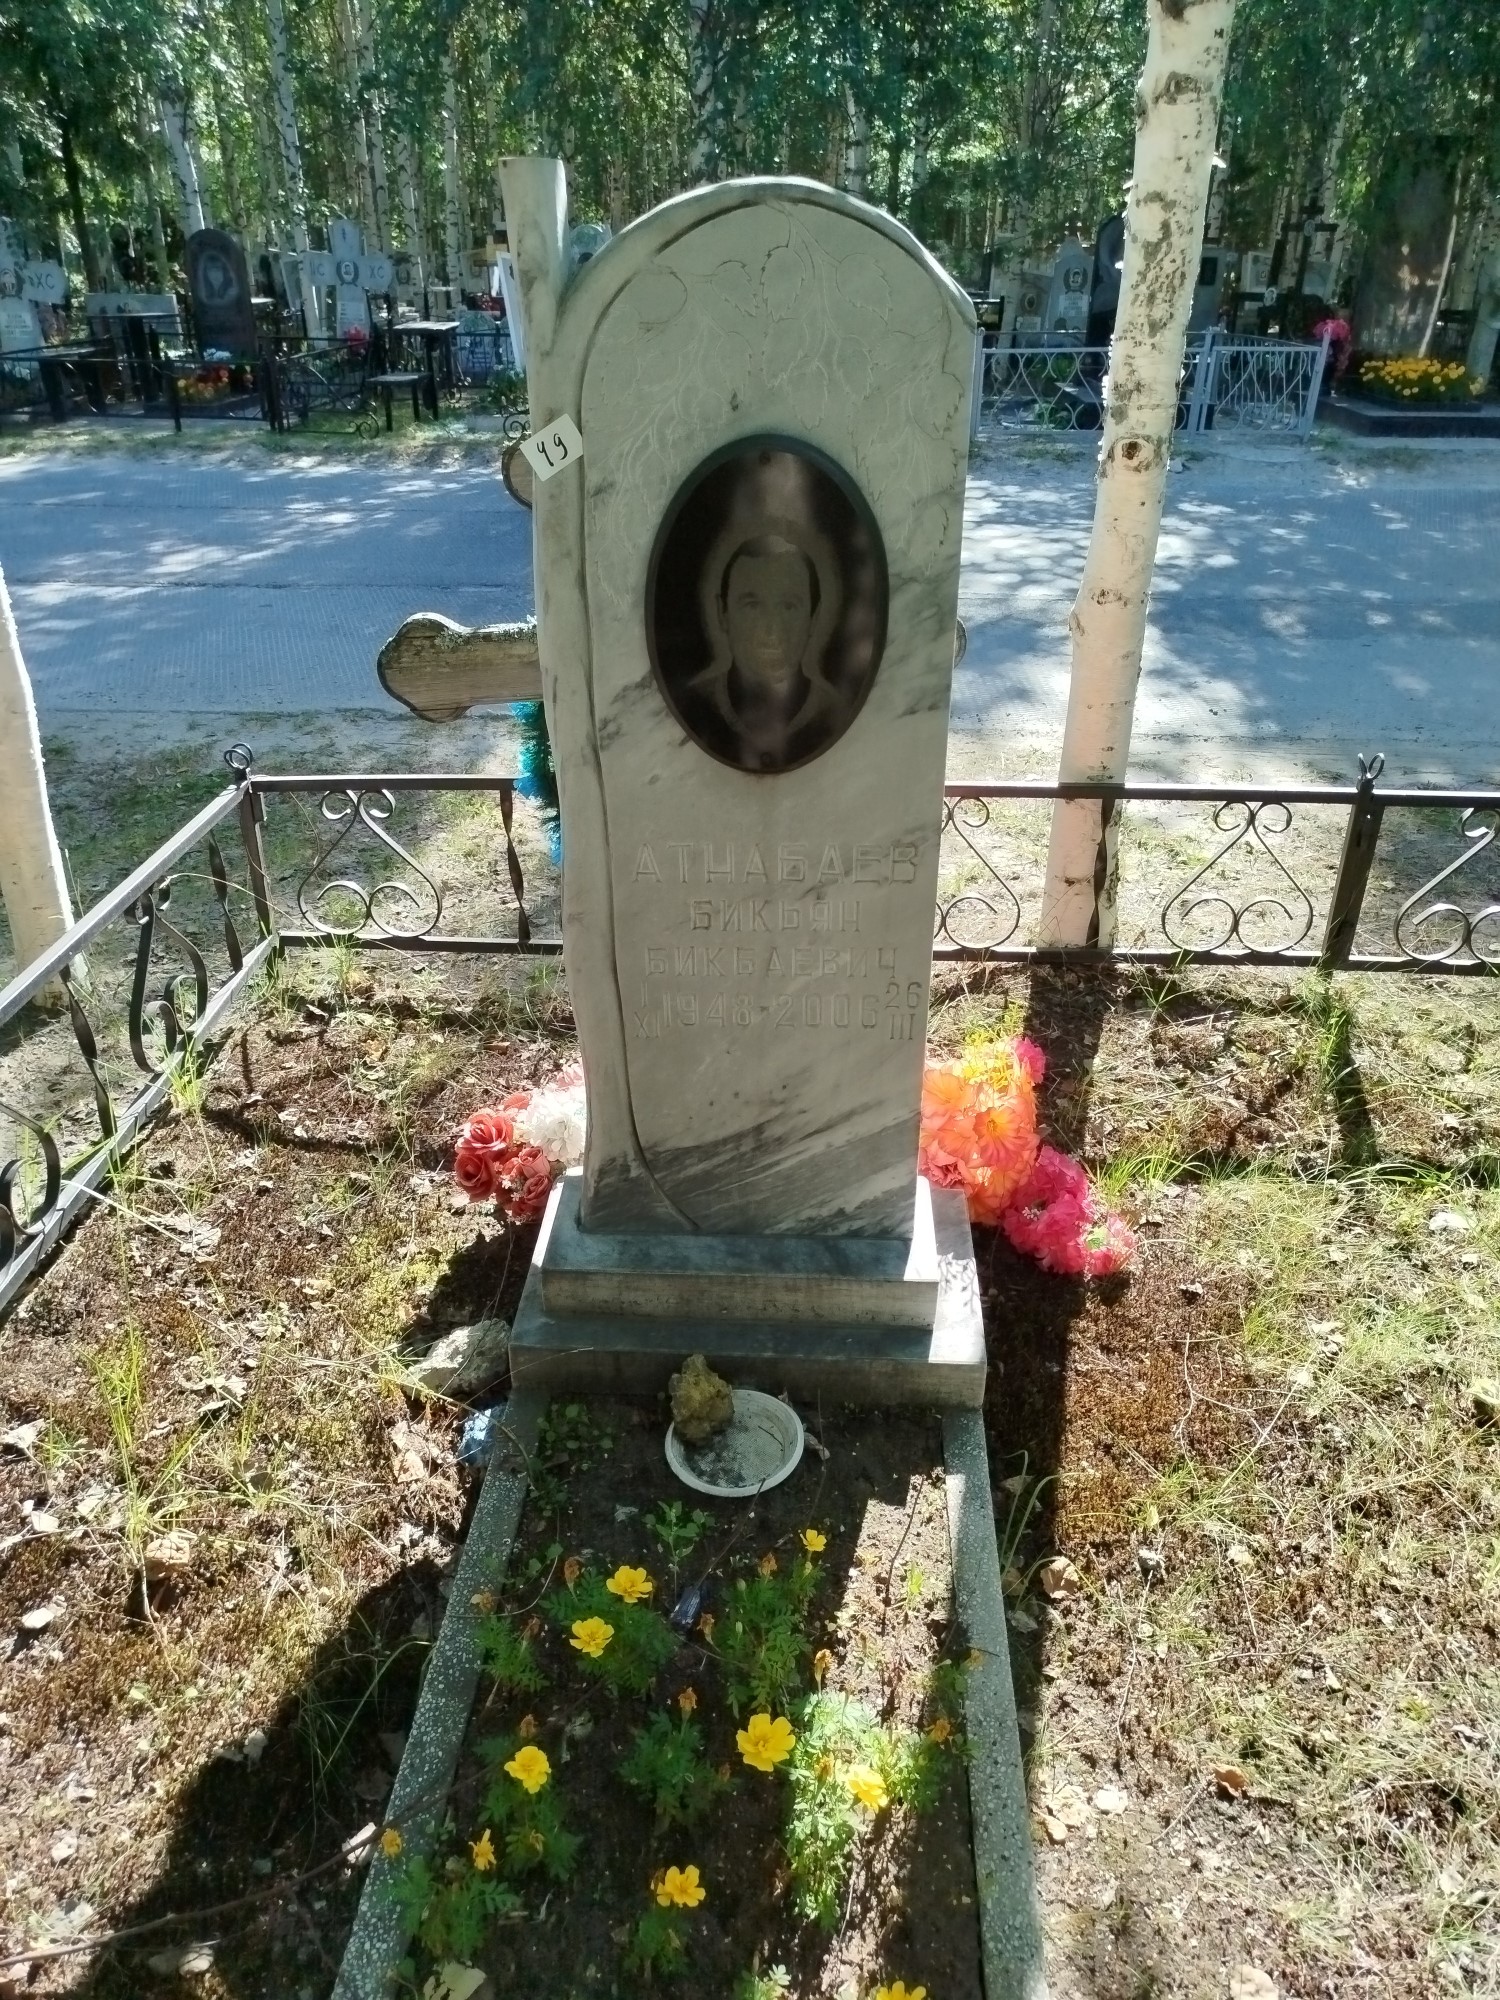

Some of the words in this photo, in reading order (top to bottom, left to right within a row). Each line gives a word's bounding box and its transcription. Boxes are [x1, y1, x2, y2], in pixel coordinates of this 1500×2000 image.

[536, 432, 568, 467] 49
[632, 841, 919, 884] АТНАБАЕВ
[690, 898, 861, 932] БИКЬЯН
[645, 946, 898, 979] БИКБАЕВИЧ
